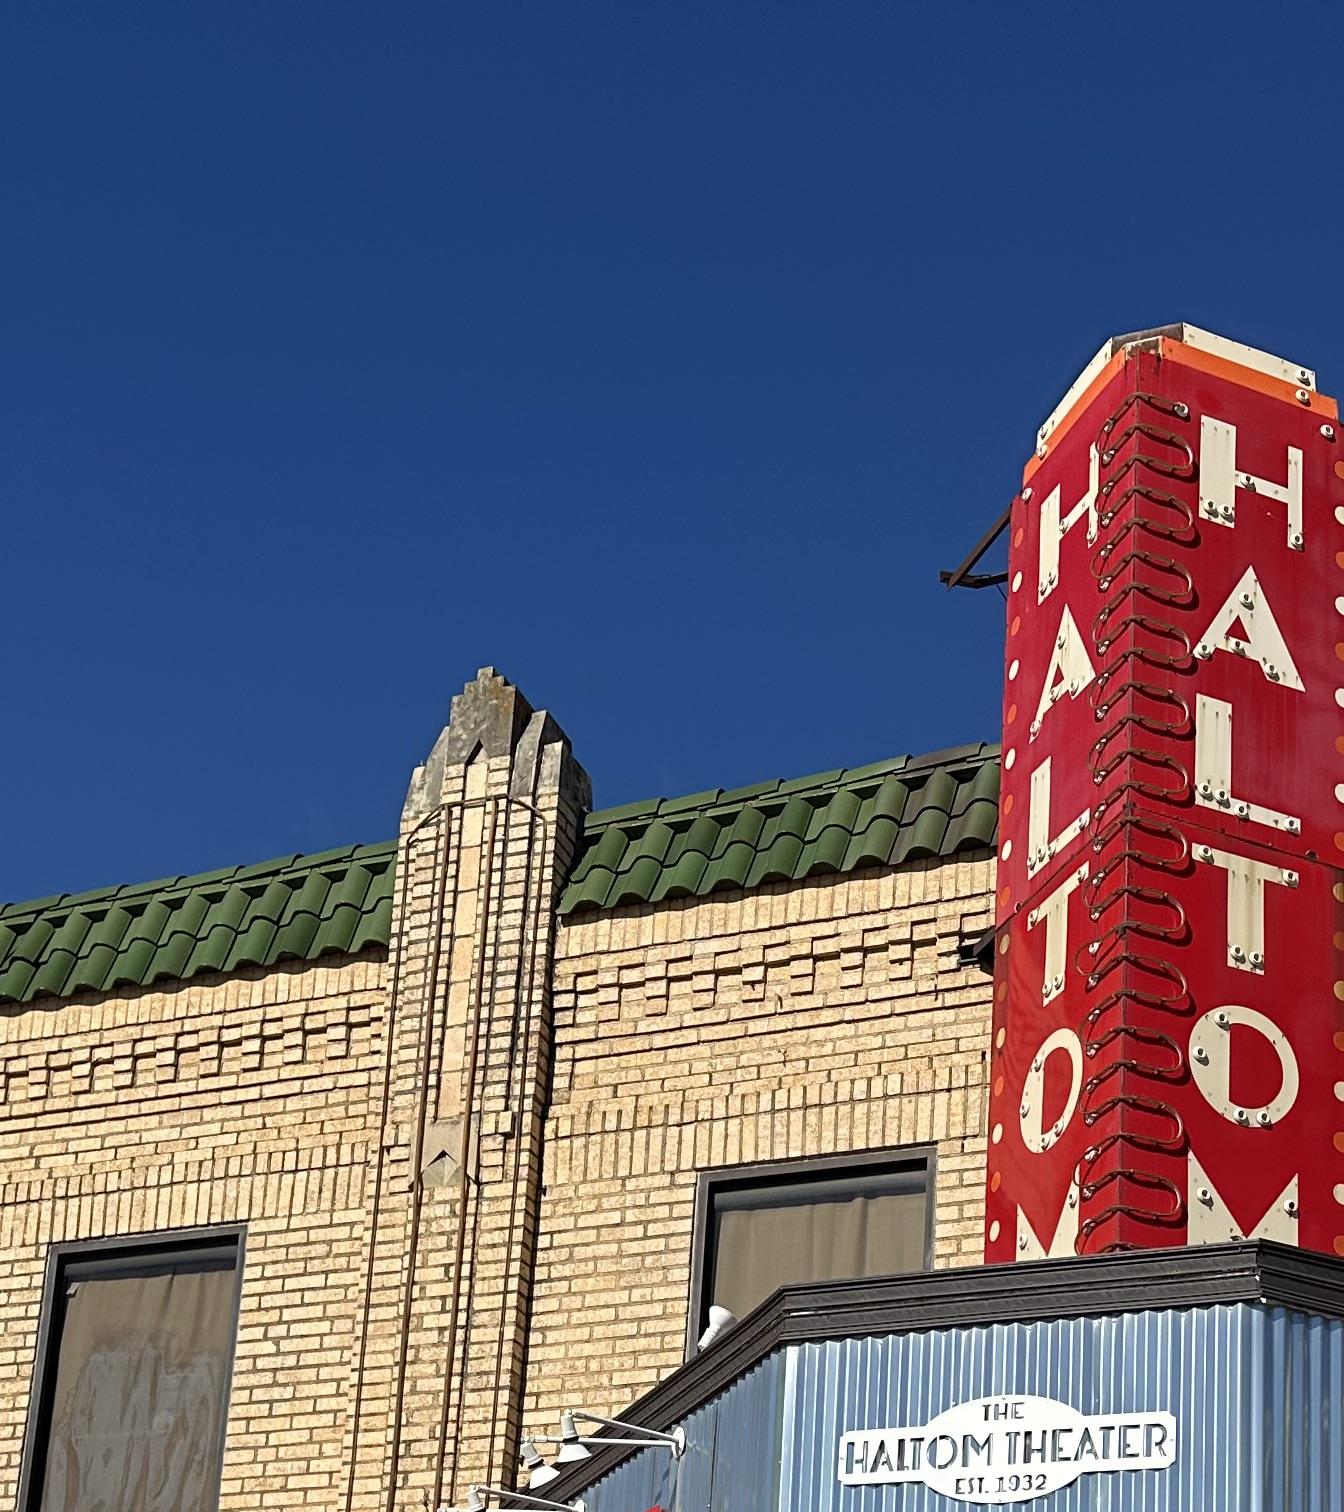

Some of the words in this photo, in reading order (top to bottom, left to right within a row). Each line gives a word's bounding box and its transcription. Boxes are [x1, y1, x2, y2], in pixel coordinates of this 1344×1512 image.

[1187, 415, 1306, 1247] HALTOM
[982, 1401, 1026, 1421] THE
[845, 1432, 994, 1475] HALTOM
[1005, 1423, 1168, 1464] THEATER
[955, 1477, 990, 1495] EST.
[996, 1474, 1048, 1494] 1932
